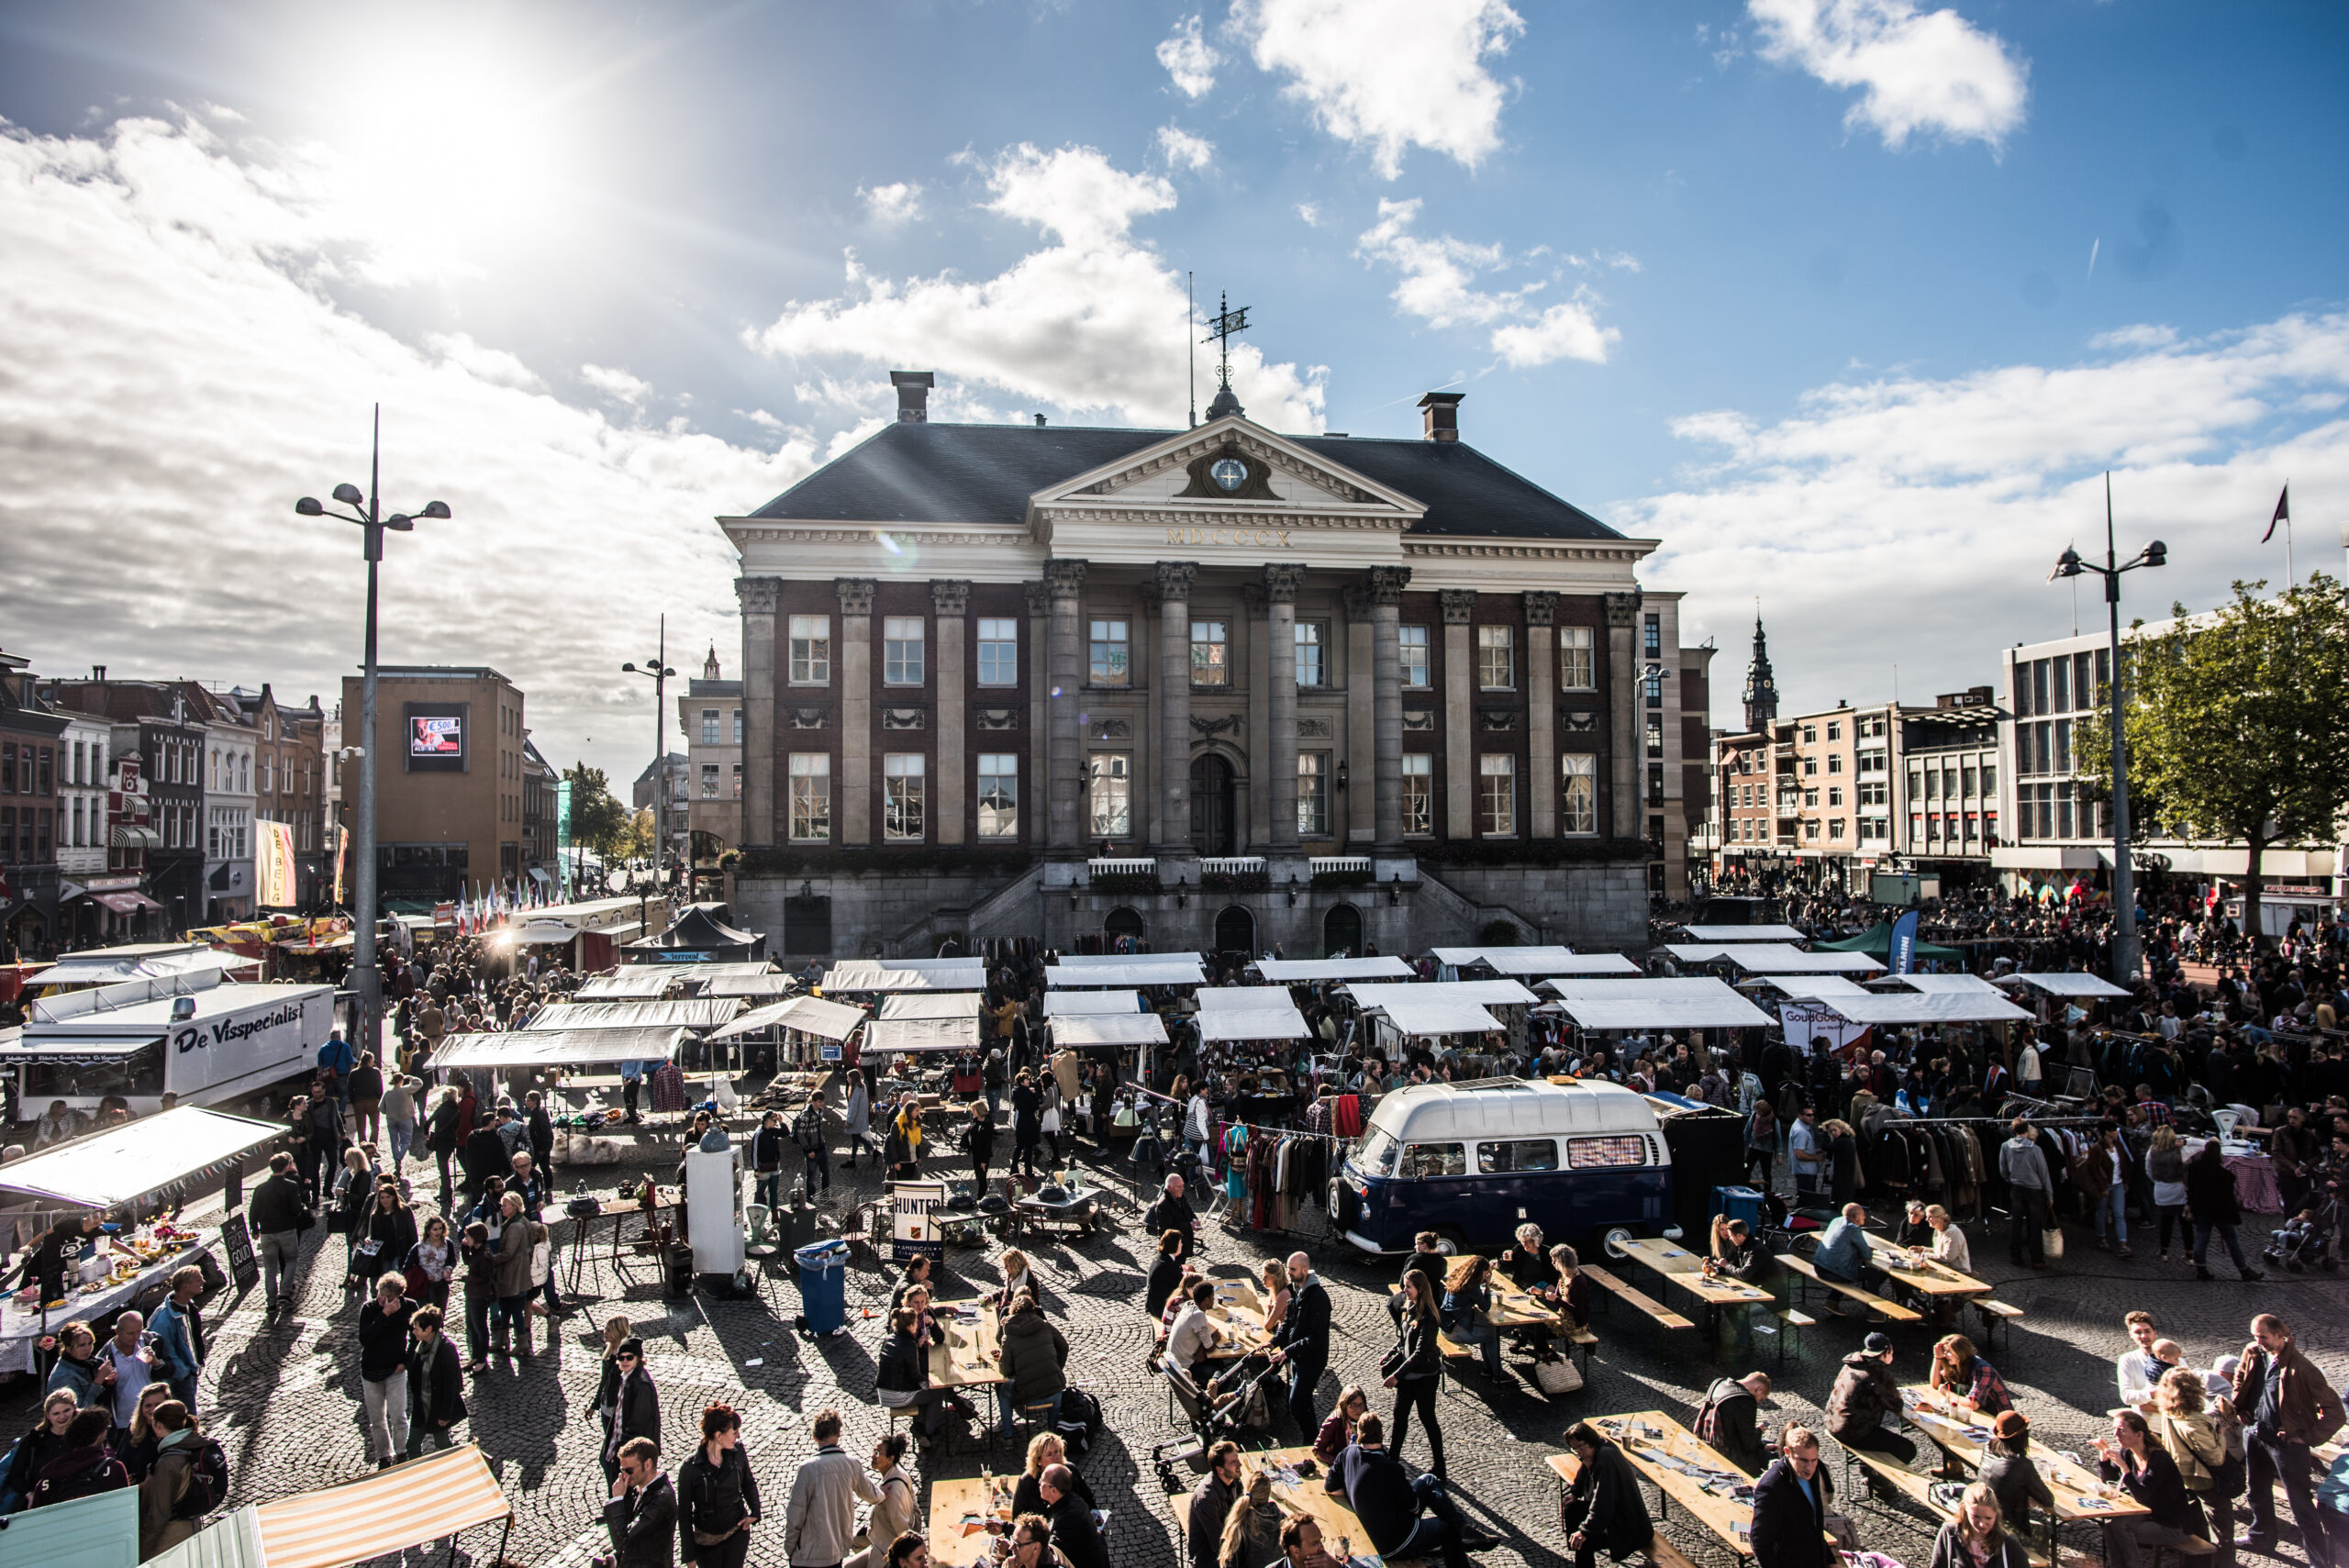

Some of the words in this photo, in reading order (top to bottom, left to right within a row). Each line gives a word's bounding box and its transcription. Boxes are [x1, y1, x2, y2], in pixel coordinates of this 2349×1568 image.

[1166, 528, 1291, 546] MDCCCX
[201, 928, 219, 941] Belg
[174, 1028, 208, 1053] De
[212, 1003, 305, 1044] Visspecialist
[232, 1245, 251, 1266] GOUD
[103, 1466, 110, 1477] J
[41, 1479, 50, 1491] S
